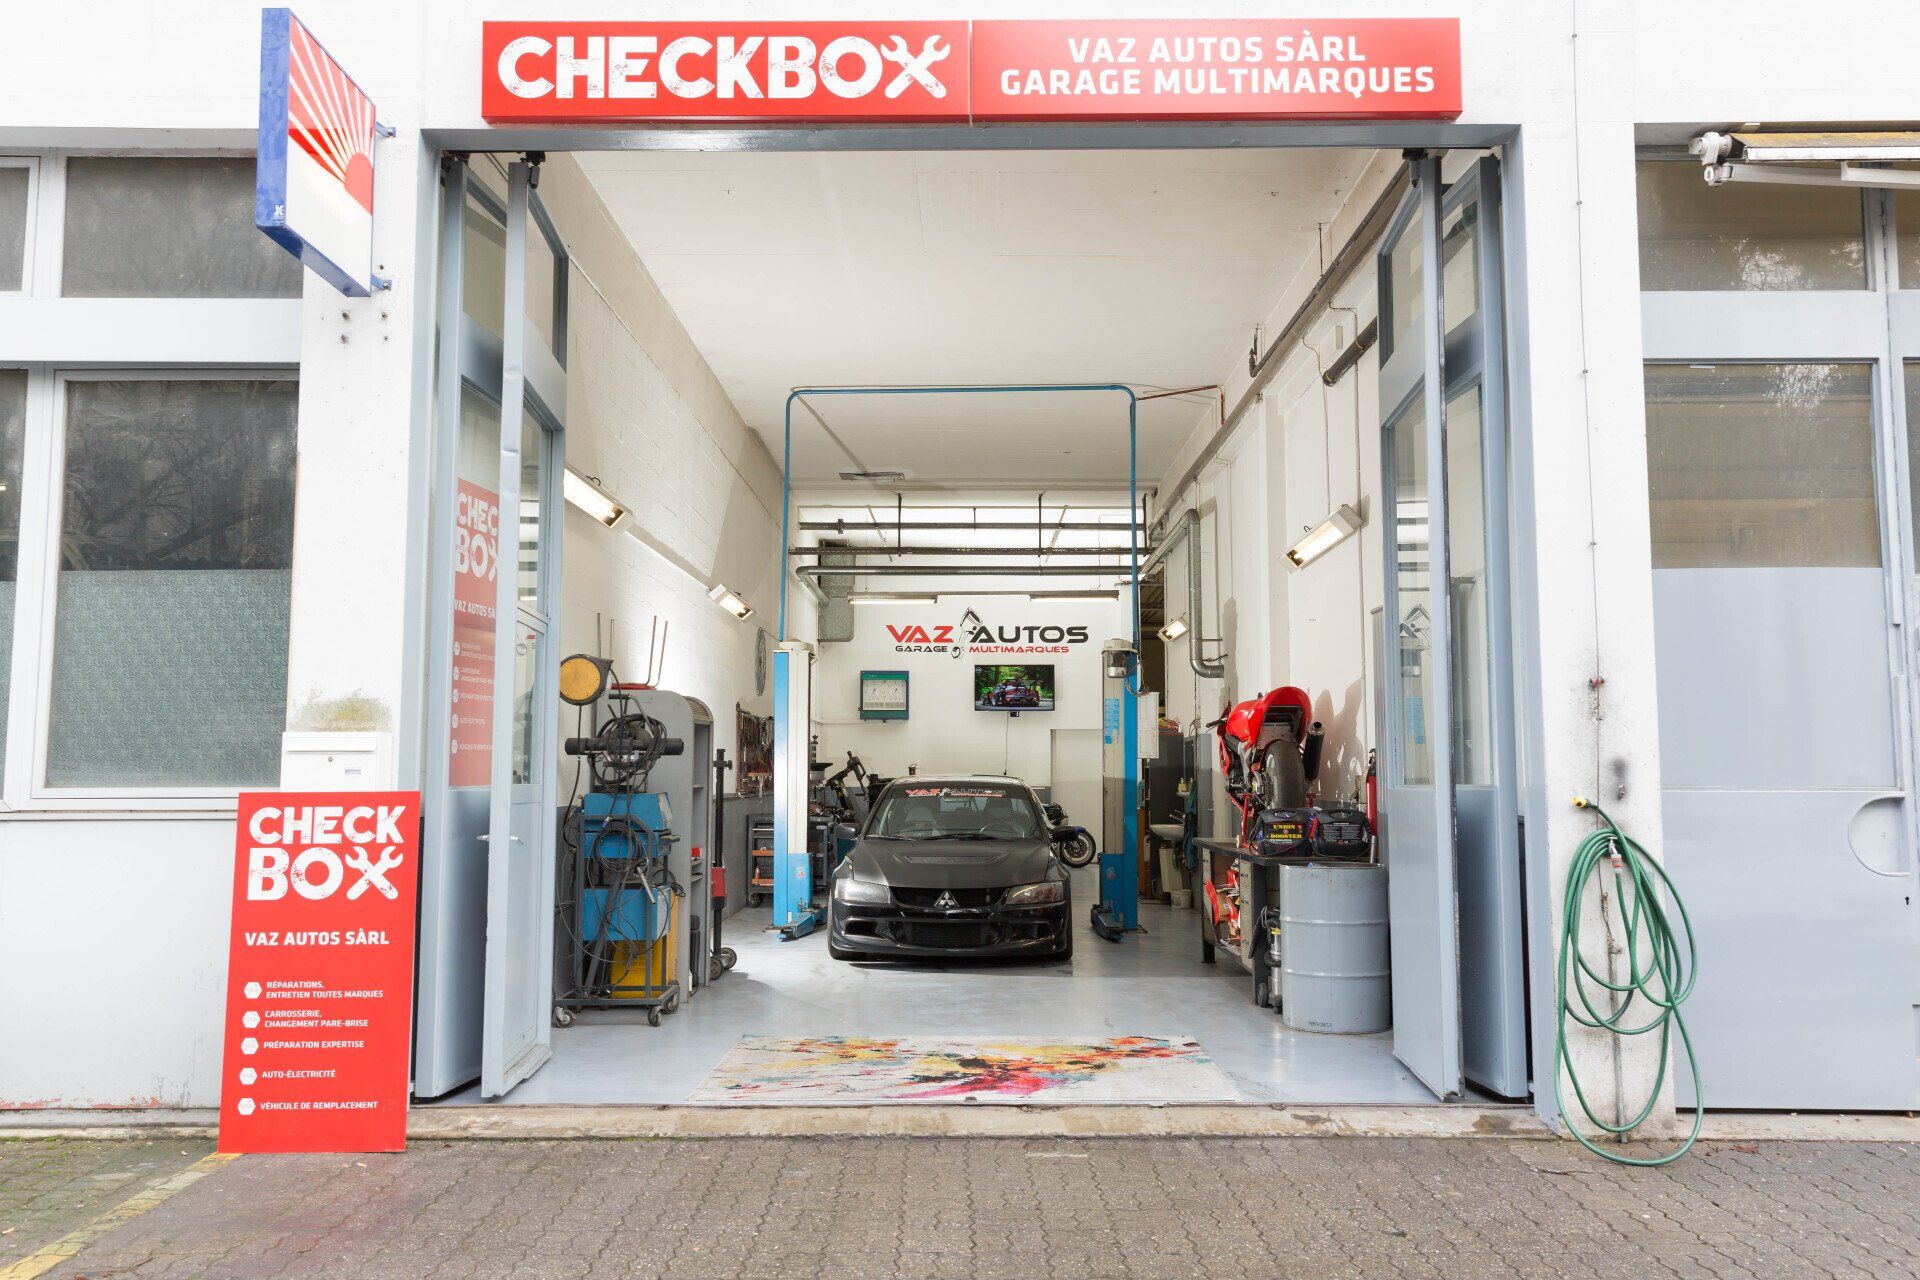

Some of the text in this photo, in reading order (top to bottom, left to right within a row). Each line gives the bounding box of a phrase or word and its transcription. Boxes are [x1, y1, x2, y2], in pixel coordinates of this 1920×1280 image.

[1067, 29, 1366, 64] VAZ AUTOS SÀRL
[498, 34, 951, 99] CHECKBOX
[1001, 66, 1435, 98] GARAGE MULTIMARQUES
[885, 624, 1089, 644] VAZ AUTOS
[895, 645, 1070, 653] GARAGE MULTIMARQUES
[249, 805, 407, 845] CHECK
[247, 846, 404, 901] BOX
[244, 928, 390, 946] VAZ AUTOS SÀRL
[266, 991, 310, 999] ENTRETIEN
[344, 990, 384, 999] MARQUES
[264, 1019, 369, 1028] CHANGEMENT PARE-BRISE
[263, 1040, 365, 1049] PRÉPARATION EXPERTISE
[261, 1069, 336, 1079] AUTO-ÉLECTRICITÉ
[260, 1101, 378, 1110] VÉHICULE DE REMPLACEMENT
